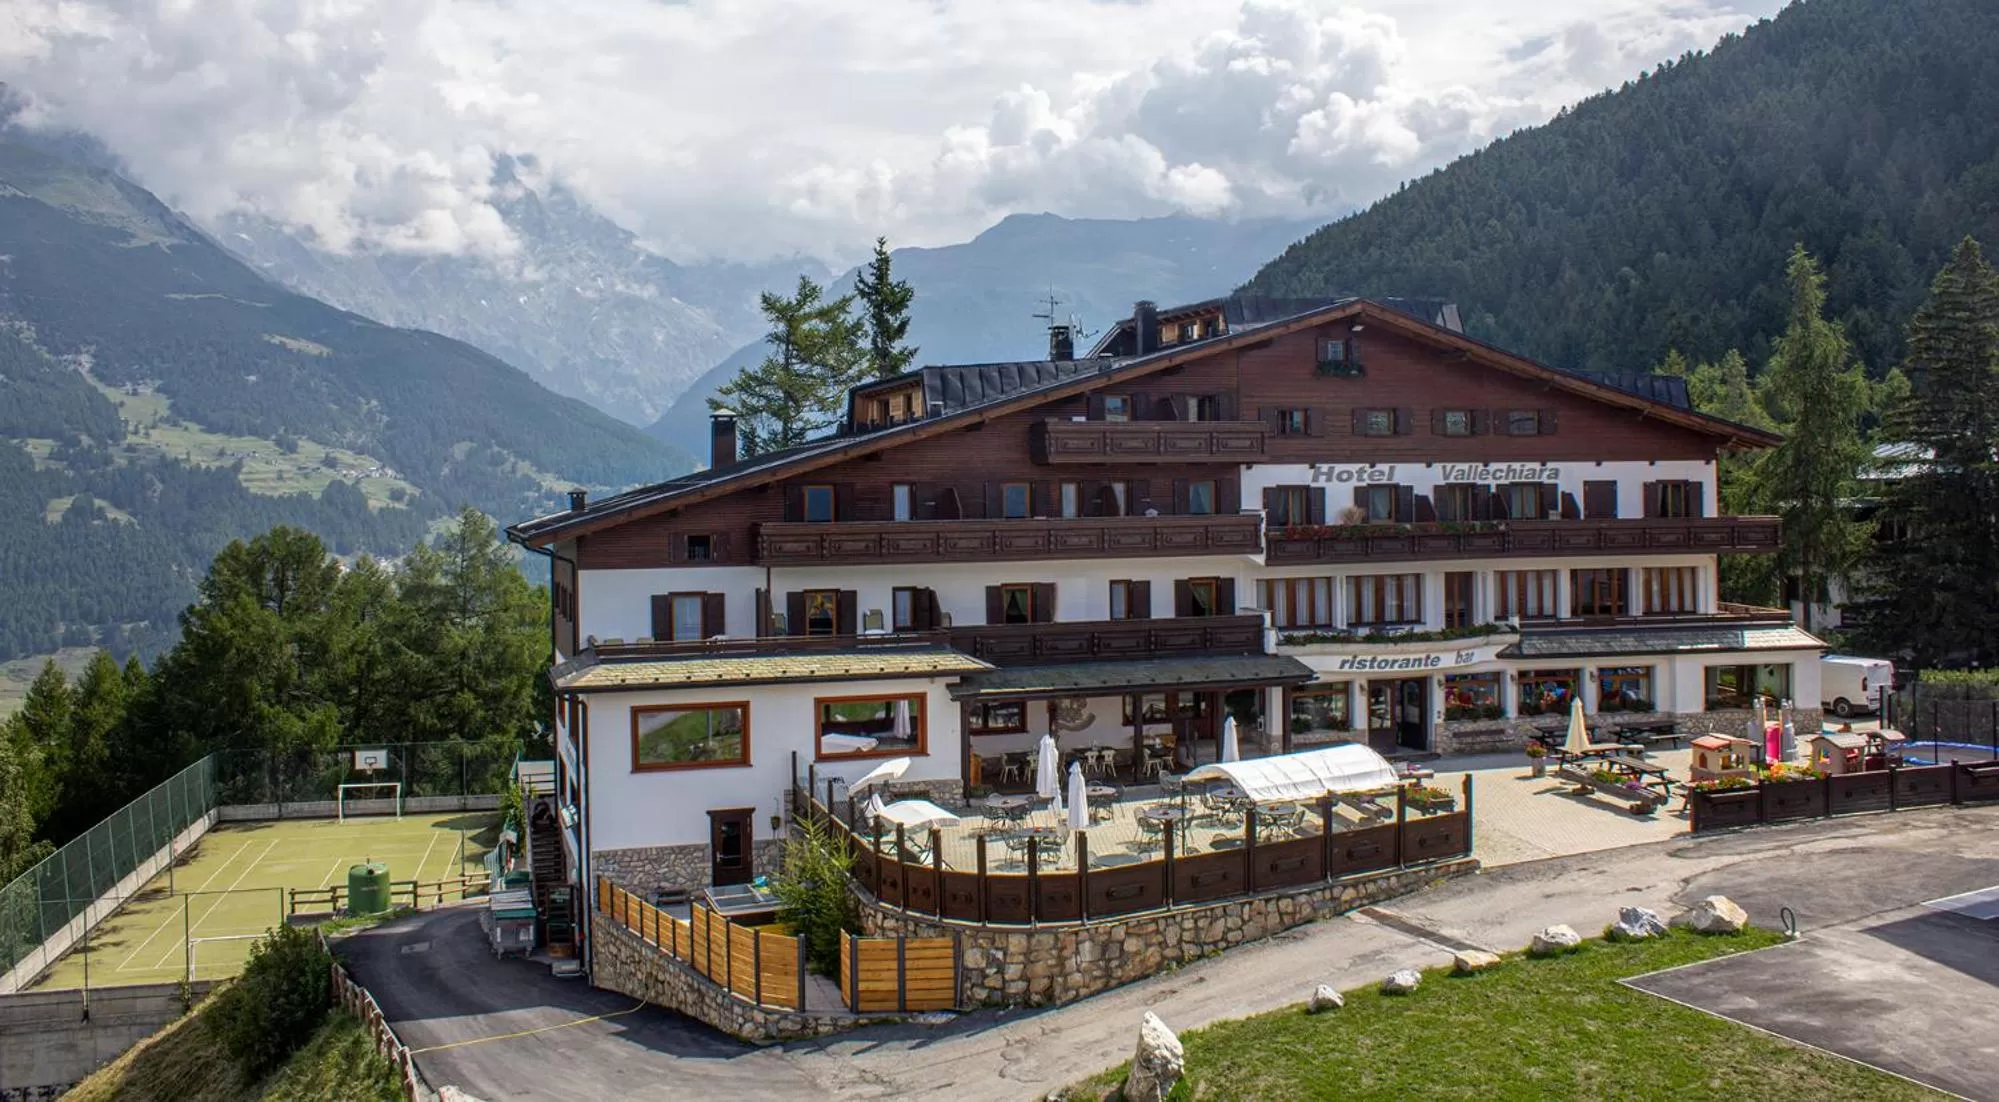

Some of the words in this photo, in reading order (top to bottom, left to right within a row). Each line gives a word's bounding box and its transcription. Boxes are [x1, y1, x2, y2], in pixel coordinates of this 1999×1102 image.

[1312, 466, 1395, 482] Hotel
[1441, 464, 1561, 481] Vallechiara
[1339, 654, 1441, 670] ristorante
[1454, 651, 1475, 665] bar
